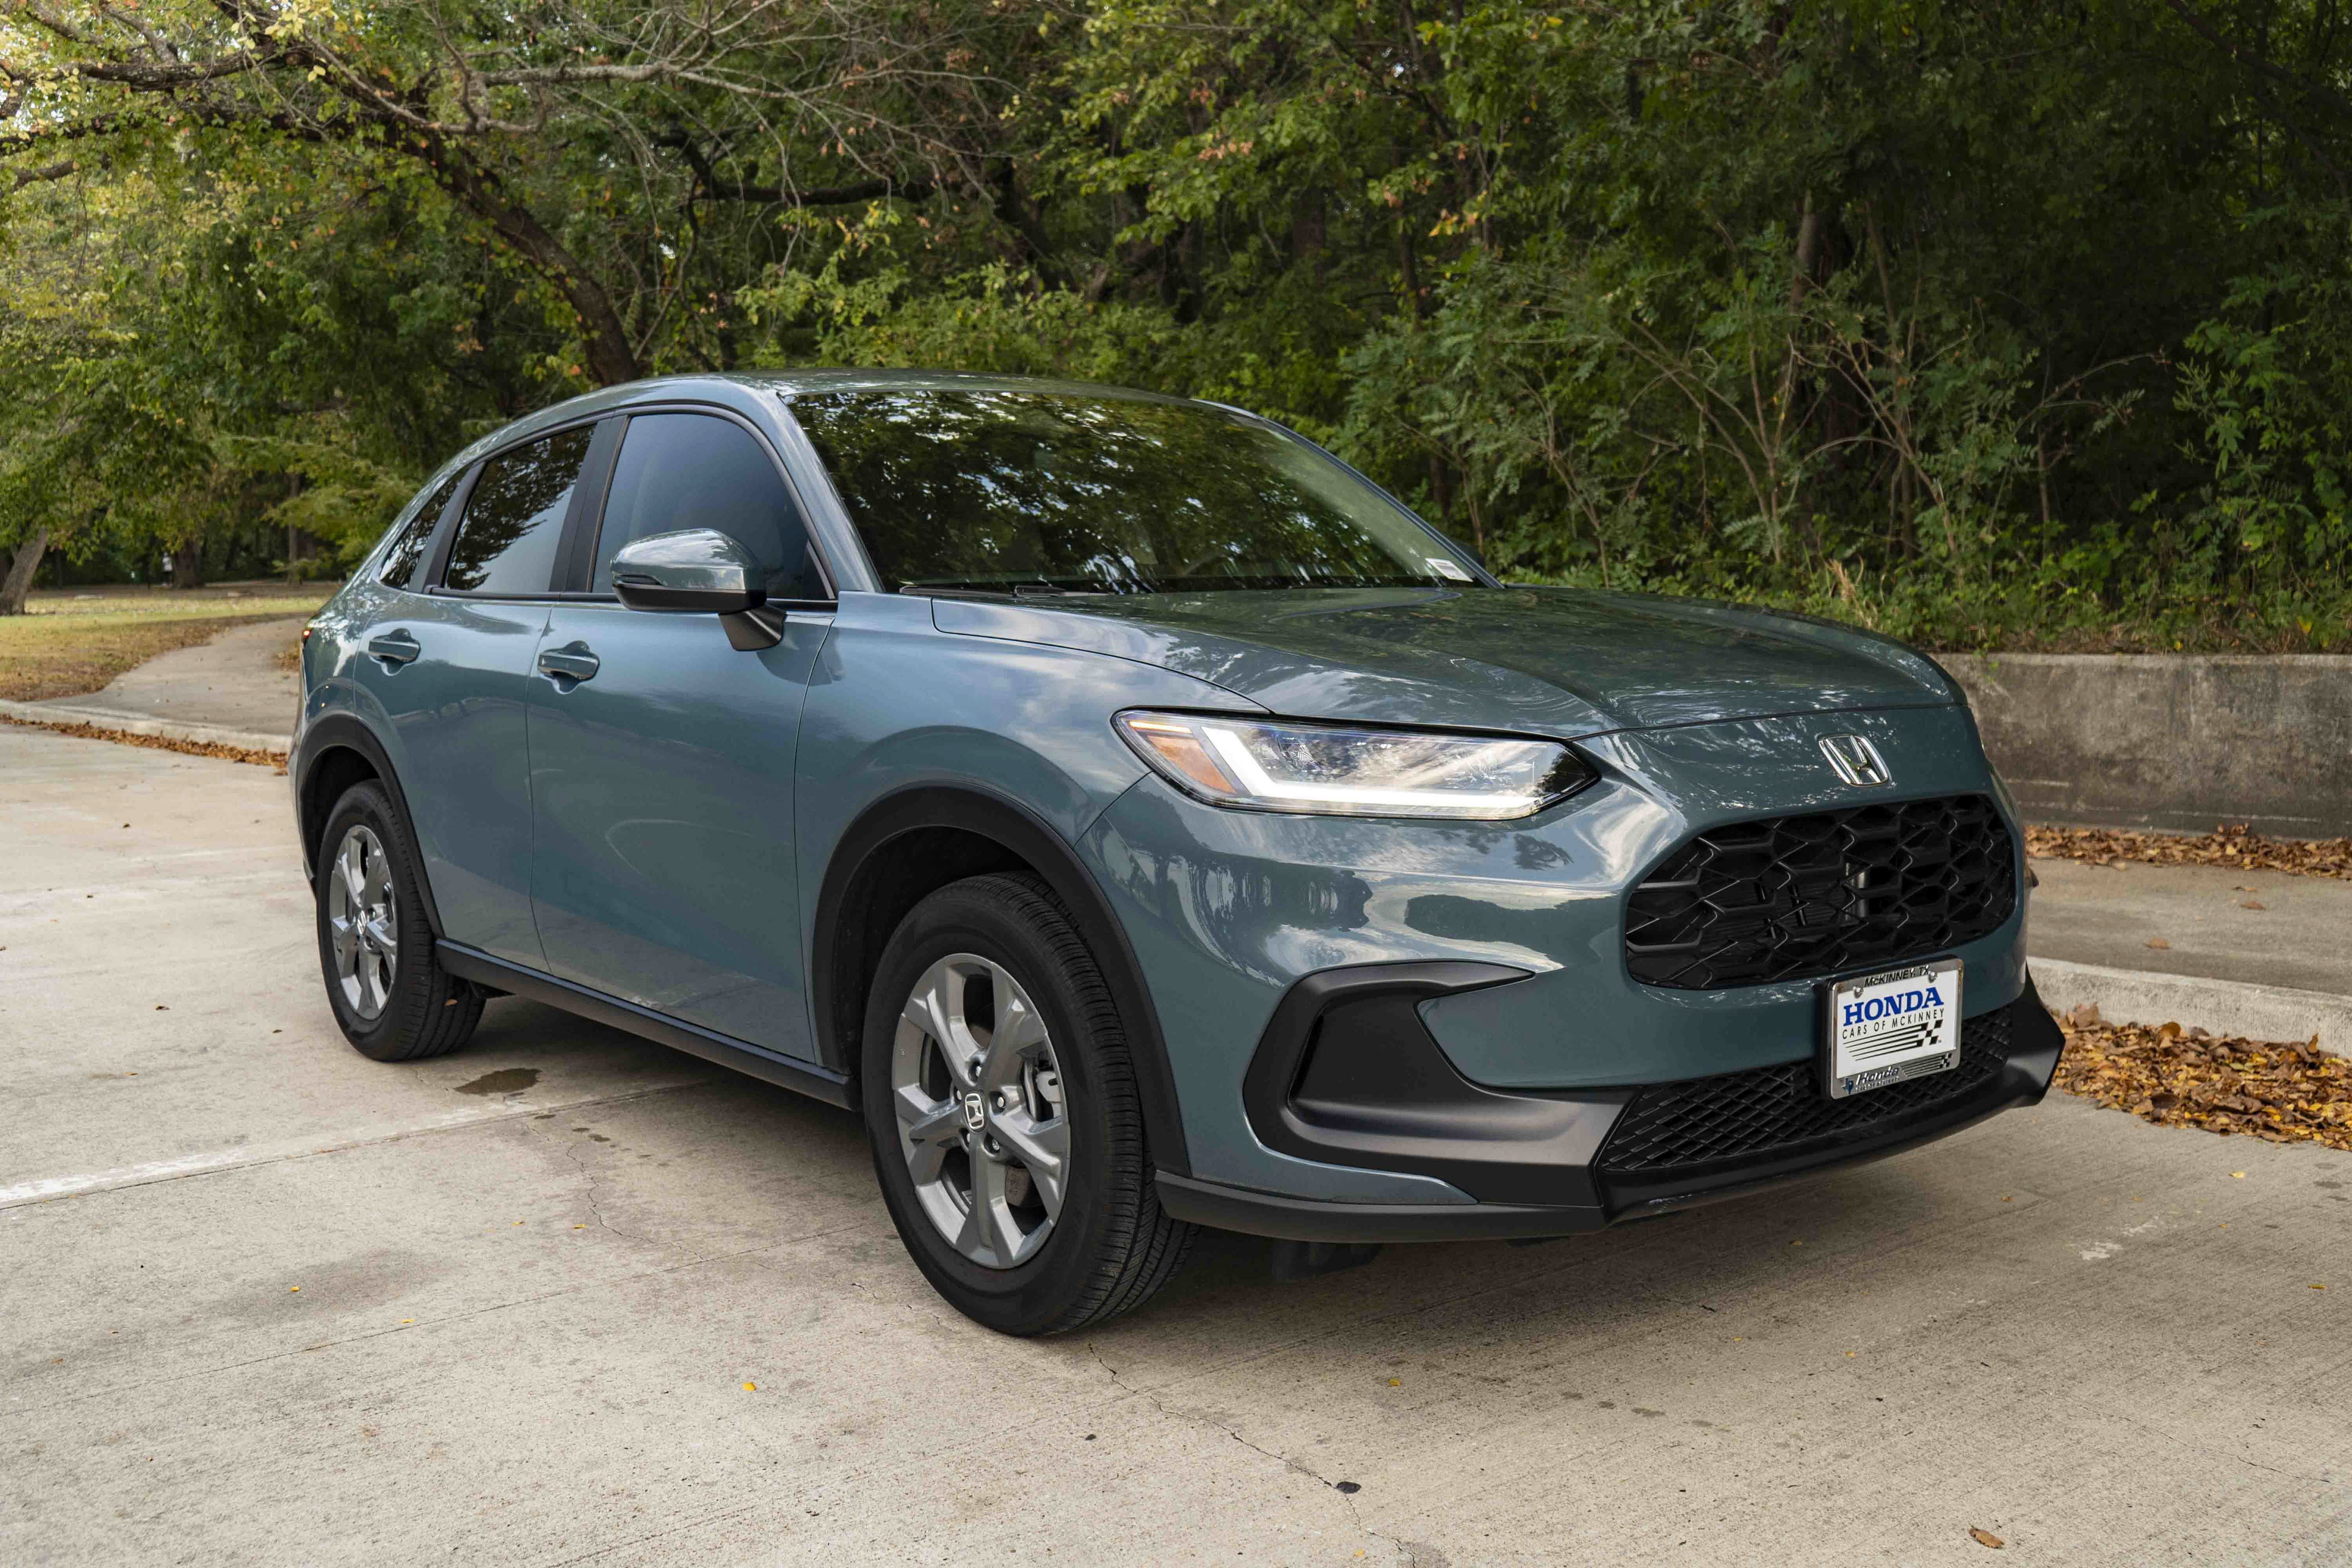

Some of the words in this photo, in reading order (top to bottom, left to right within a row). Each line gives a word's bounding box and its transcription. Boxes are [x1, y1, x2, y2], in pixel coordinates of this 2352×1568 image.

[1919, 964, 1929, 976] TX
[1843, 987, 1944, 1026] HONDA
[1842, 1025, 1867, 1039] CARS
[1874, 1021, 1886, 1031] OF
[1892, 1009, 1944, 1028] MCKINNEY
